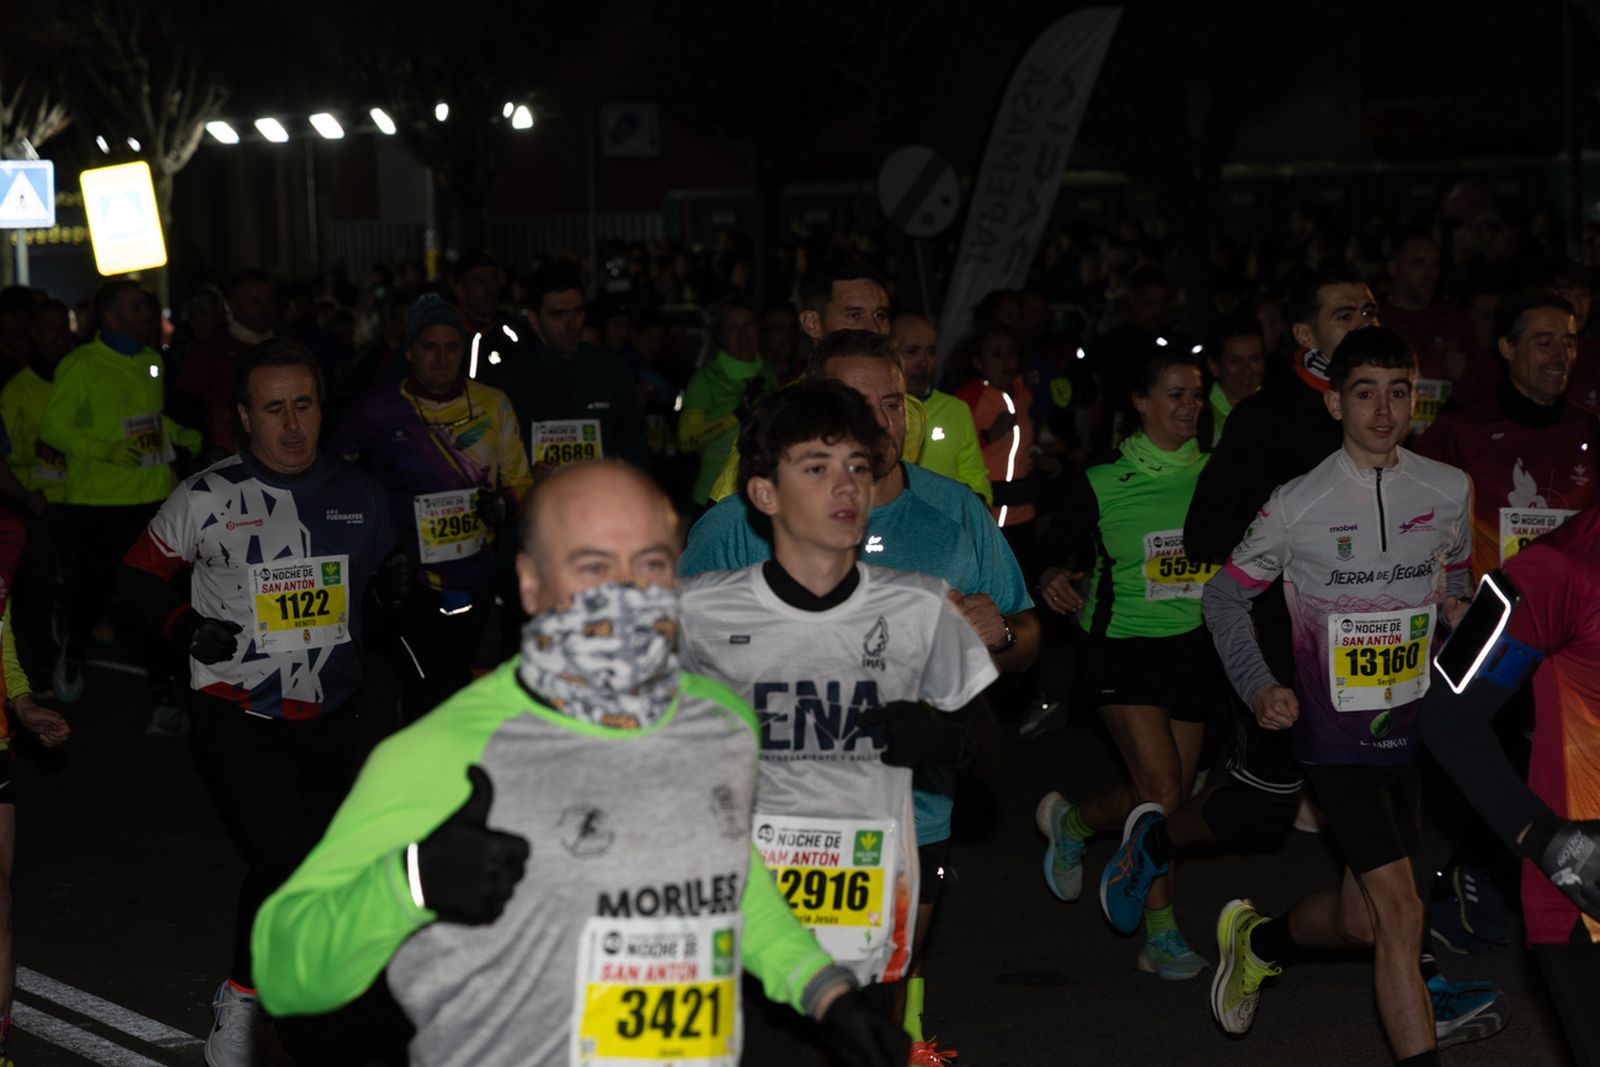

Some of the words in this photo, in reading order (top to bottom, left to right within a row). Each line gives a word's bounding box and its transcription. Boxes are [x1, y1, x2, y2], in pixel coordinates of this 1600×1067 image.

[1330, 524, 1358, 533] mobel
[1521, 518, 1545, 526] NOCHE
[272, 569, 300, 580] NOCHE
[302, 568, 314, 578] DE
[1325, 570, 1374, 586] SIERRA
[1376, 571, 1388, 580] DE
[262, 583, 282, 594] SAN
[284, 578, 315, 592] ANTÓN
[276, 590, 330, 620] 1122
[1355, 623, 1388, 634] NOCHE
[1390, 622, 1401, 632] DE
[1342, 637, 1364, 646] SAN
[1366, 632, 1402, 646] ANTÓN
[1346, 642, 1420, 676] 13160
[777, 833, 821, 848] NOCHE
[824, 835, 842, 848] DE
[790, 848, 840, 866] ANTÓN
[597, 872, 737, 918] MORILES
[770, 870, 870, 911] 2916
[602, 964, 640, 981] SAN
[616, 986, 720, 1040] 3421
